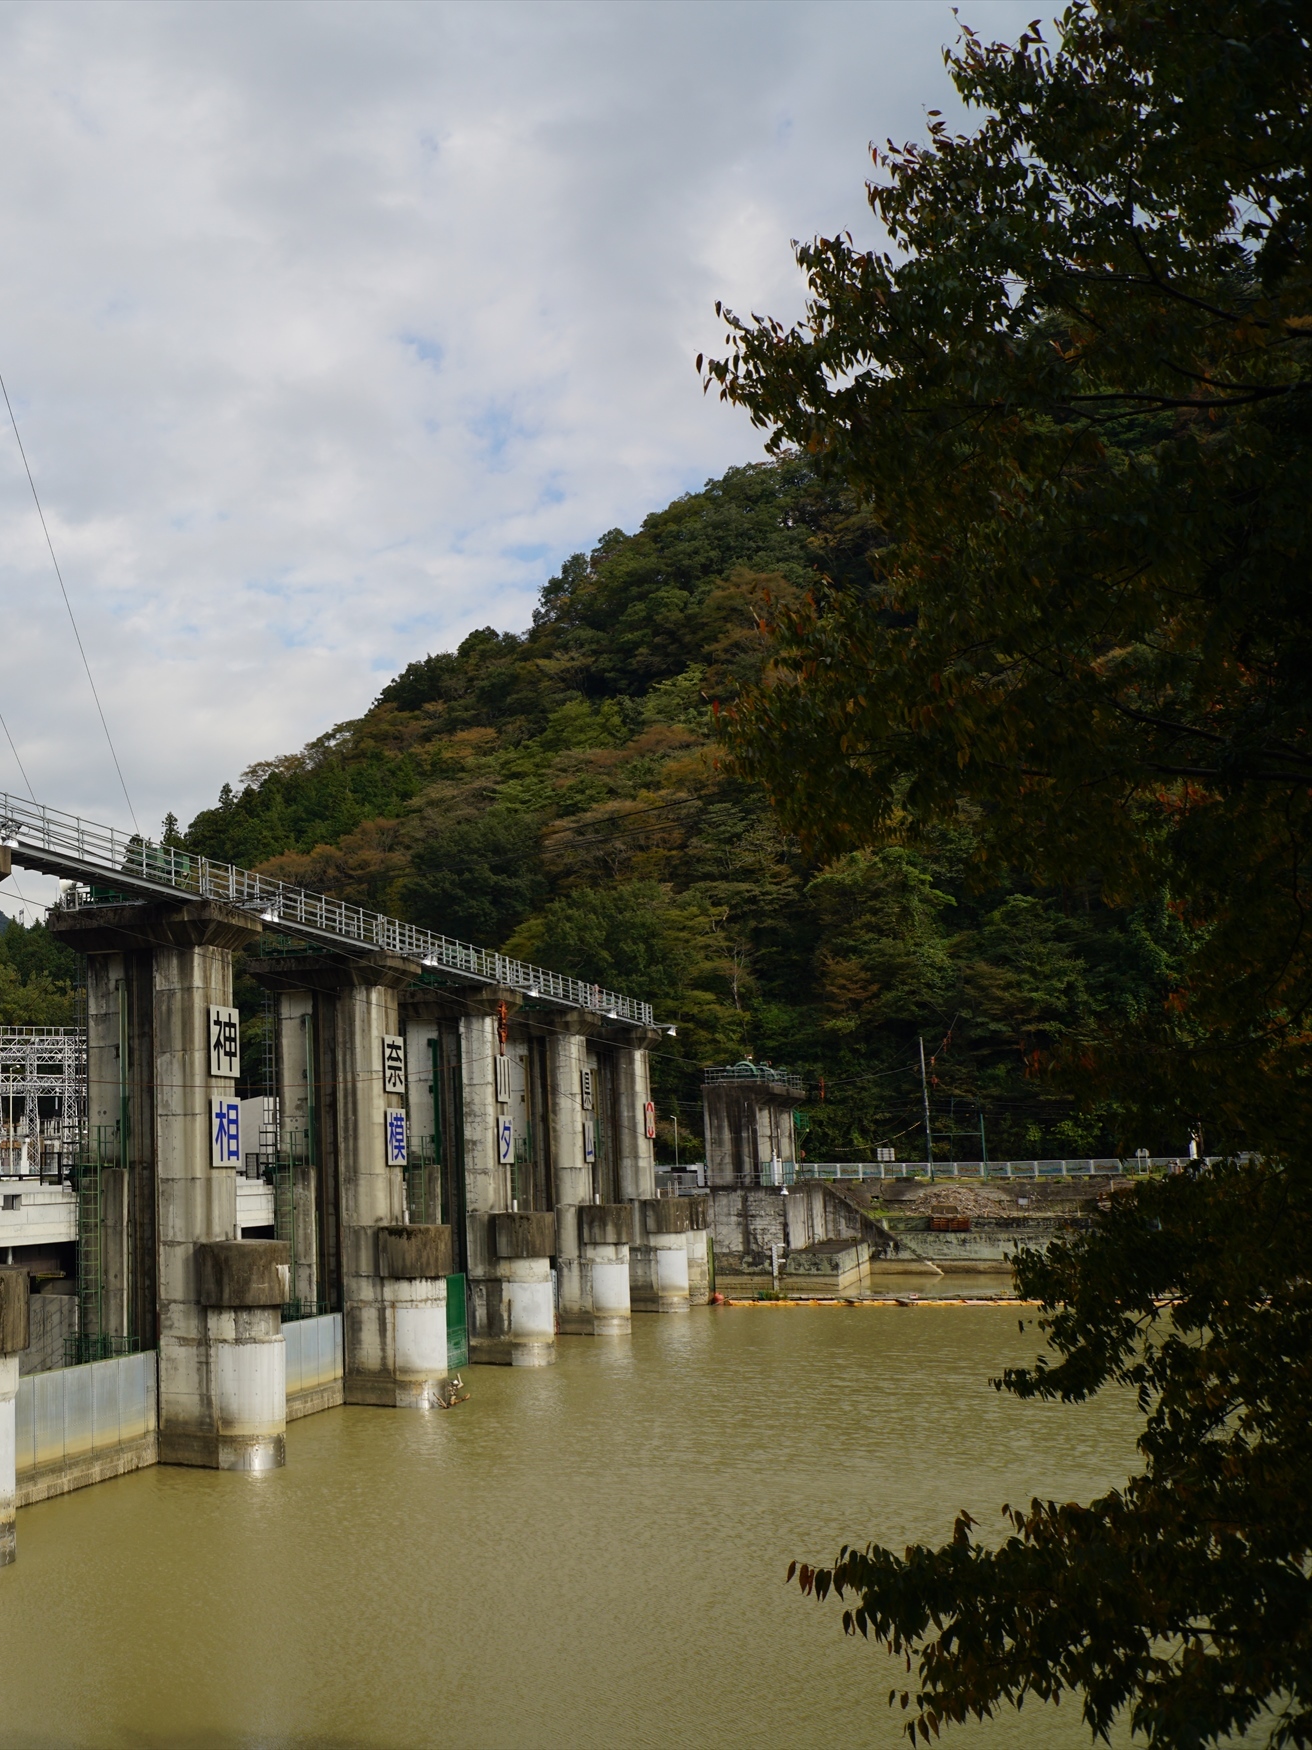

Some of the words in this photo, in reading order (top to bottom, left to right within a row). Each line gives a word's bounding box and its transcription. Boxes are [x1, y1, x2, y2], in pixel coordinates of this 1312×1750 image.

[213, 1010, 237, 1072] 神
[386, 1040, 403, 1087] 奈
[499, 1058, 510, 1099] 川
[215, 1100, 239, 1162] 相
[389, 1112, 405, 1161] 模
[501, 1119, 512, 1159] ダ
[586, 1125, 594, 1157] ム
